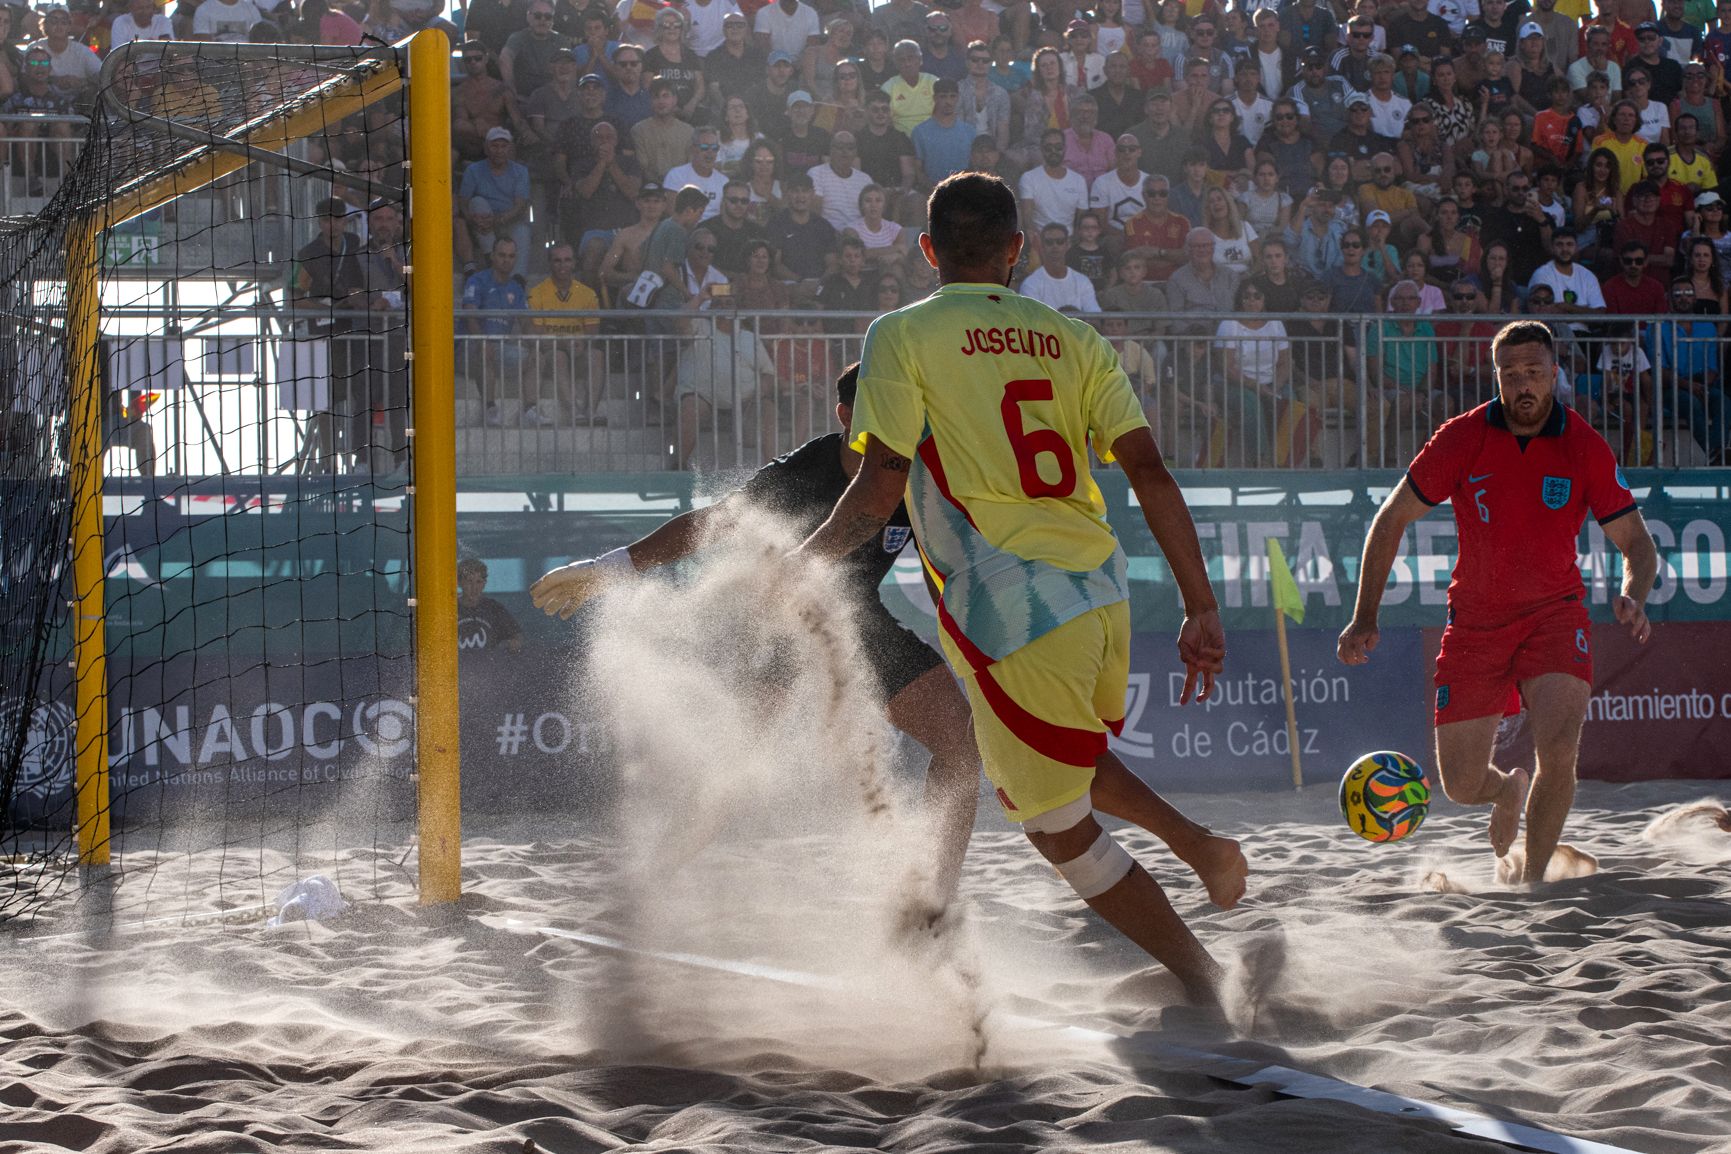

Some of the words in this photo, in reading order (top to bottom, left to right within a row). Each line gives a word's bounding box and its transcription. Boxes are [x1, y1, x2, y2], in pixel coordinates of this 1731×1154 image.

[1486, 38, 1507, 52] ANS
[961, 327, 1060, 359] JOSELITO
[1001, 379, 1077, 498] 6
[1474, 488, 1489, 523] 6
[1586, 688, 1715, 720] ntamiento
[1172, 723, 1212, 757] de
[109, 770, 149, 788] nited
[156, 768, 224, 785] Nations
[230, 765, 298, 783] Alliance
[303, 764, 320, 781] of
